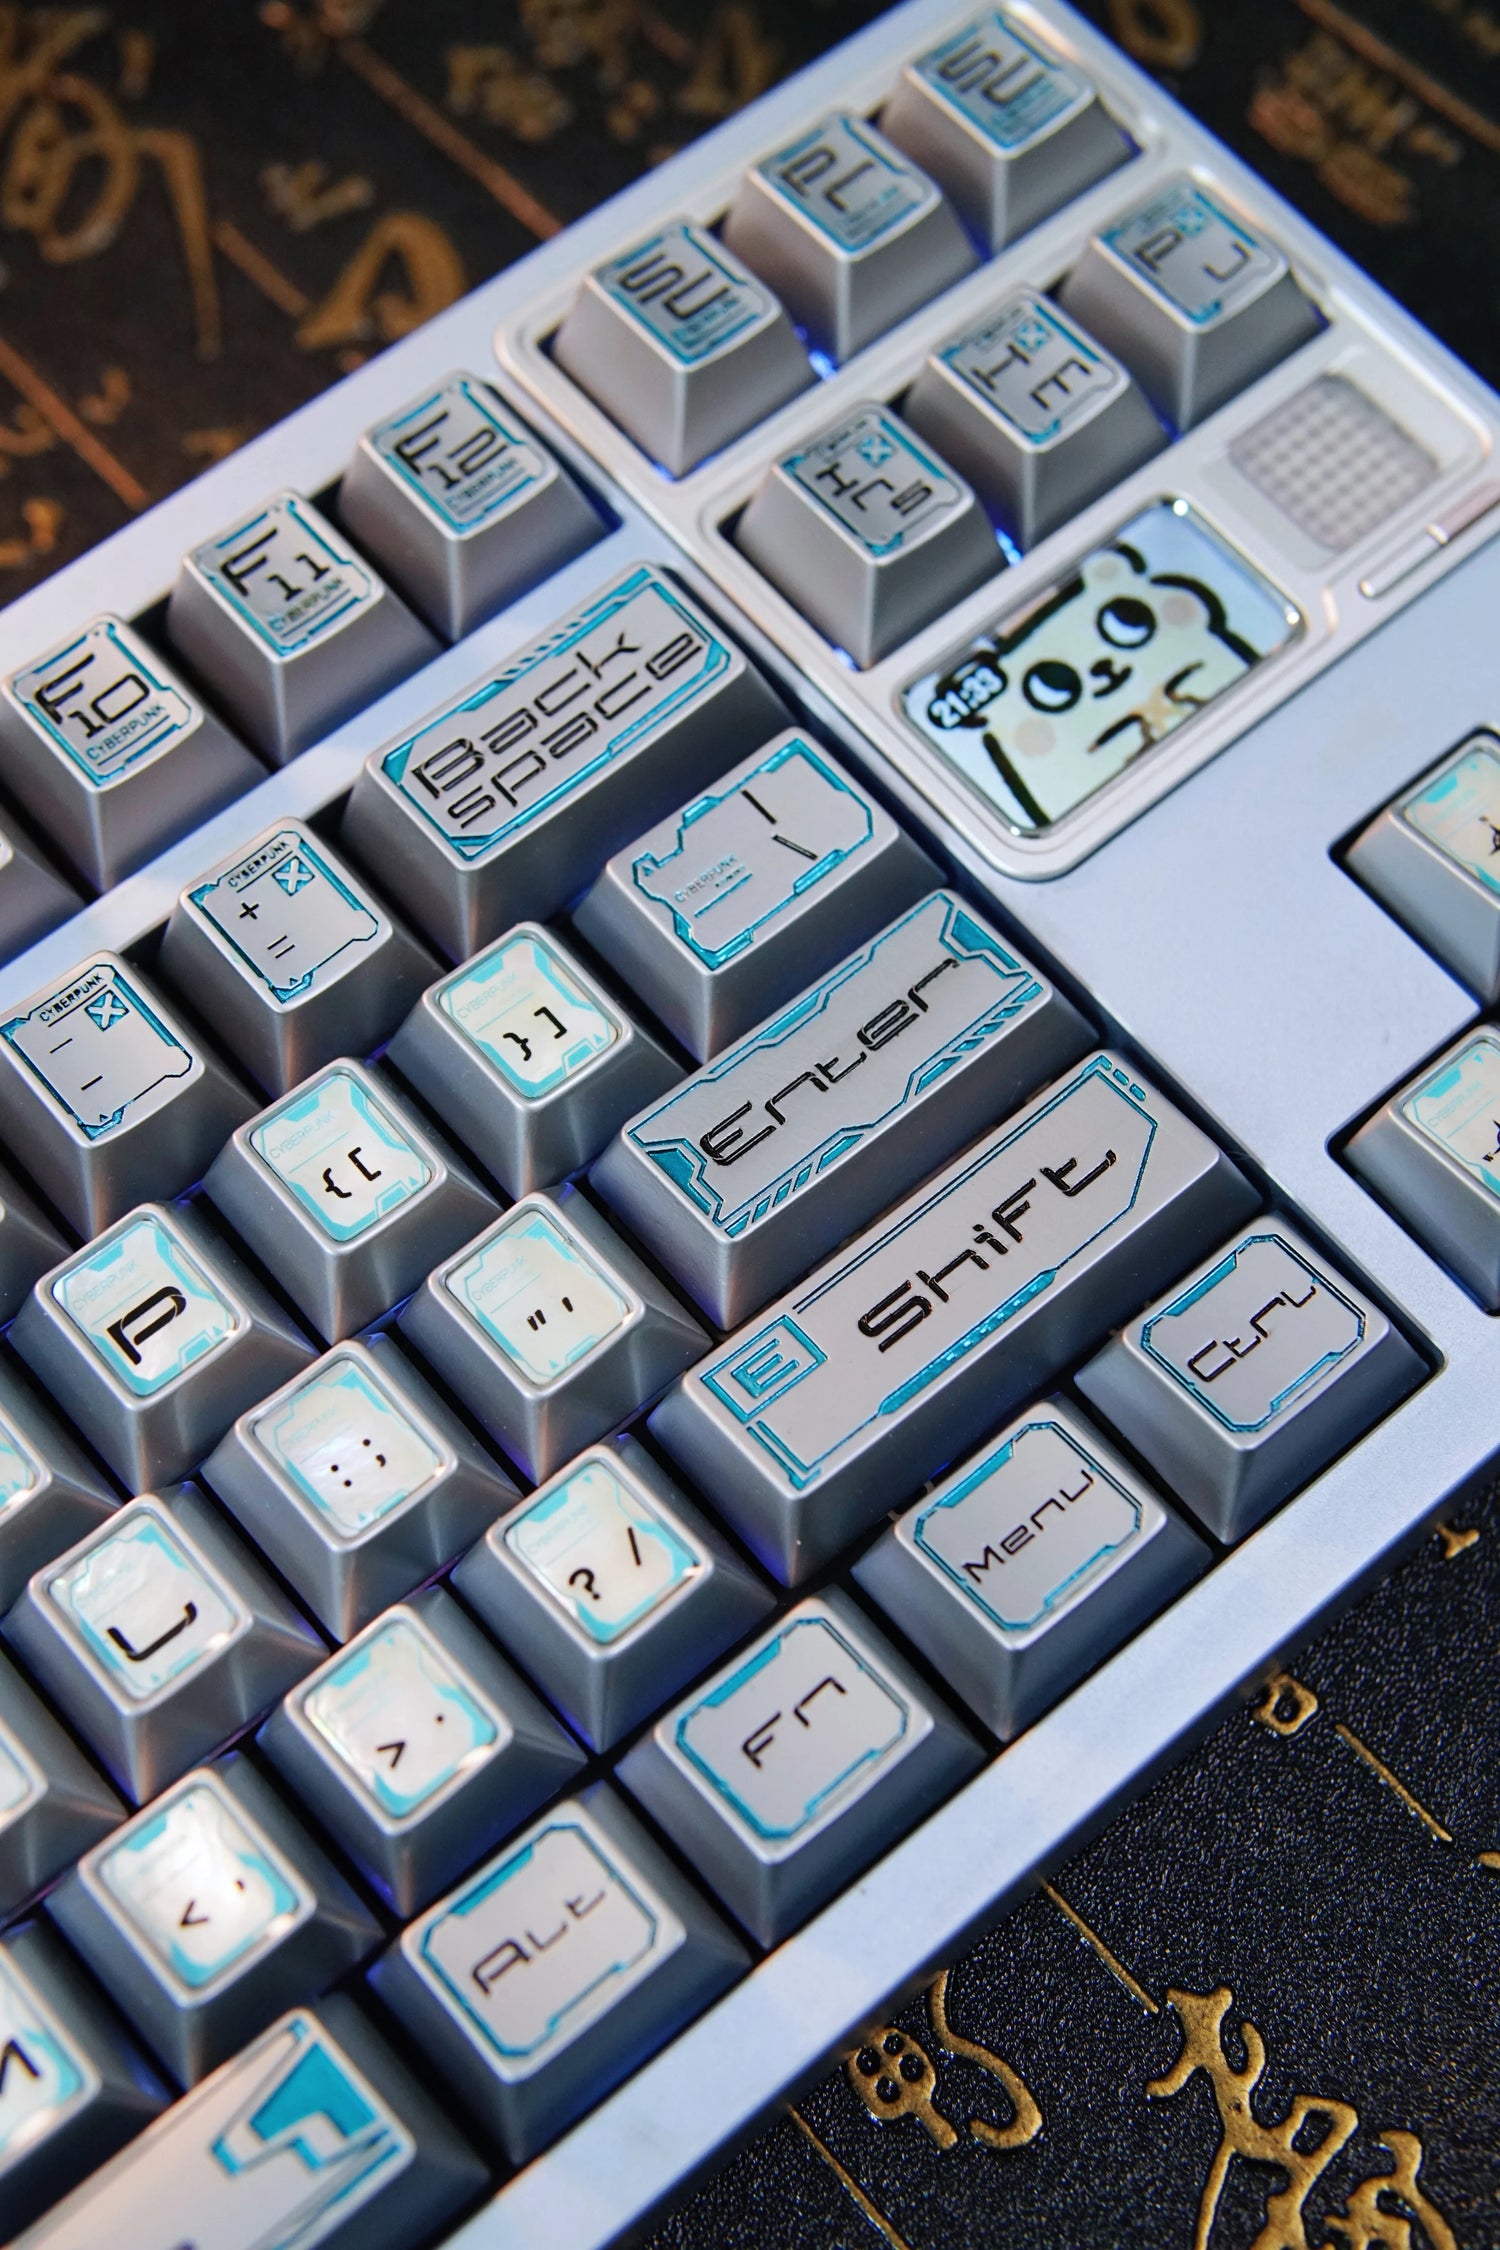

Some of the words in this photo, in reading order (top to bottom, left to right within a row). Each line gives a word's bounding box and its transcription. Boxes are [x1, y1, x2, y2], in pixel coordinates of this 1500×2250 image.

[411, 632, 643, 799] Back
[929, 665, 1004, 728] 21:33
[85, 702, 166, 760] CYBERPUNK
[448, 633, 702, 829] space
[228, 841, 289, 887] CYBERPUNK
[674, 852, 738, 902] CYBERPUNK
[239, 902, 260, 920] +
[267, 935, 295, 959] =
[39, 973, 104, 1022] CYBERPUNK
[456, 972, 519, 1019] CYBERPUNK
[700, 957, 960, 1166] Enter
[269, 1111, 334, 1159] CYBERPUNK
[72, 1259, 138, 1311] CYBERPUNK
[106, 1285, 187, 1366] P
[1188, 1286, 1316, 1382] Ctrl
[962, 1469, 1094, 1584] Menu
[742, 1676, 847, 1770] Fn
